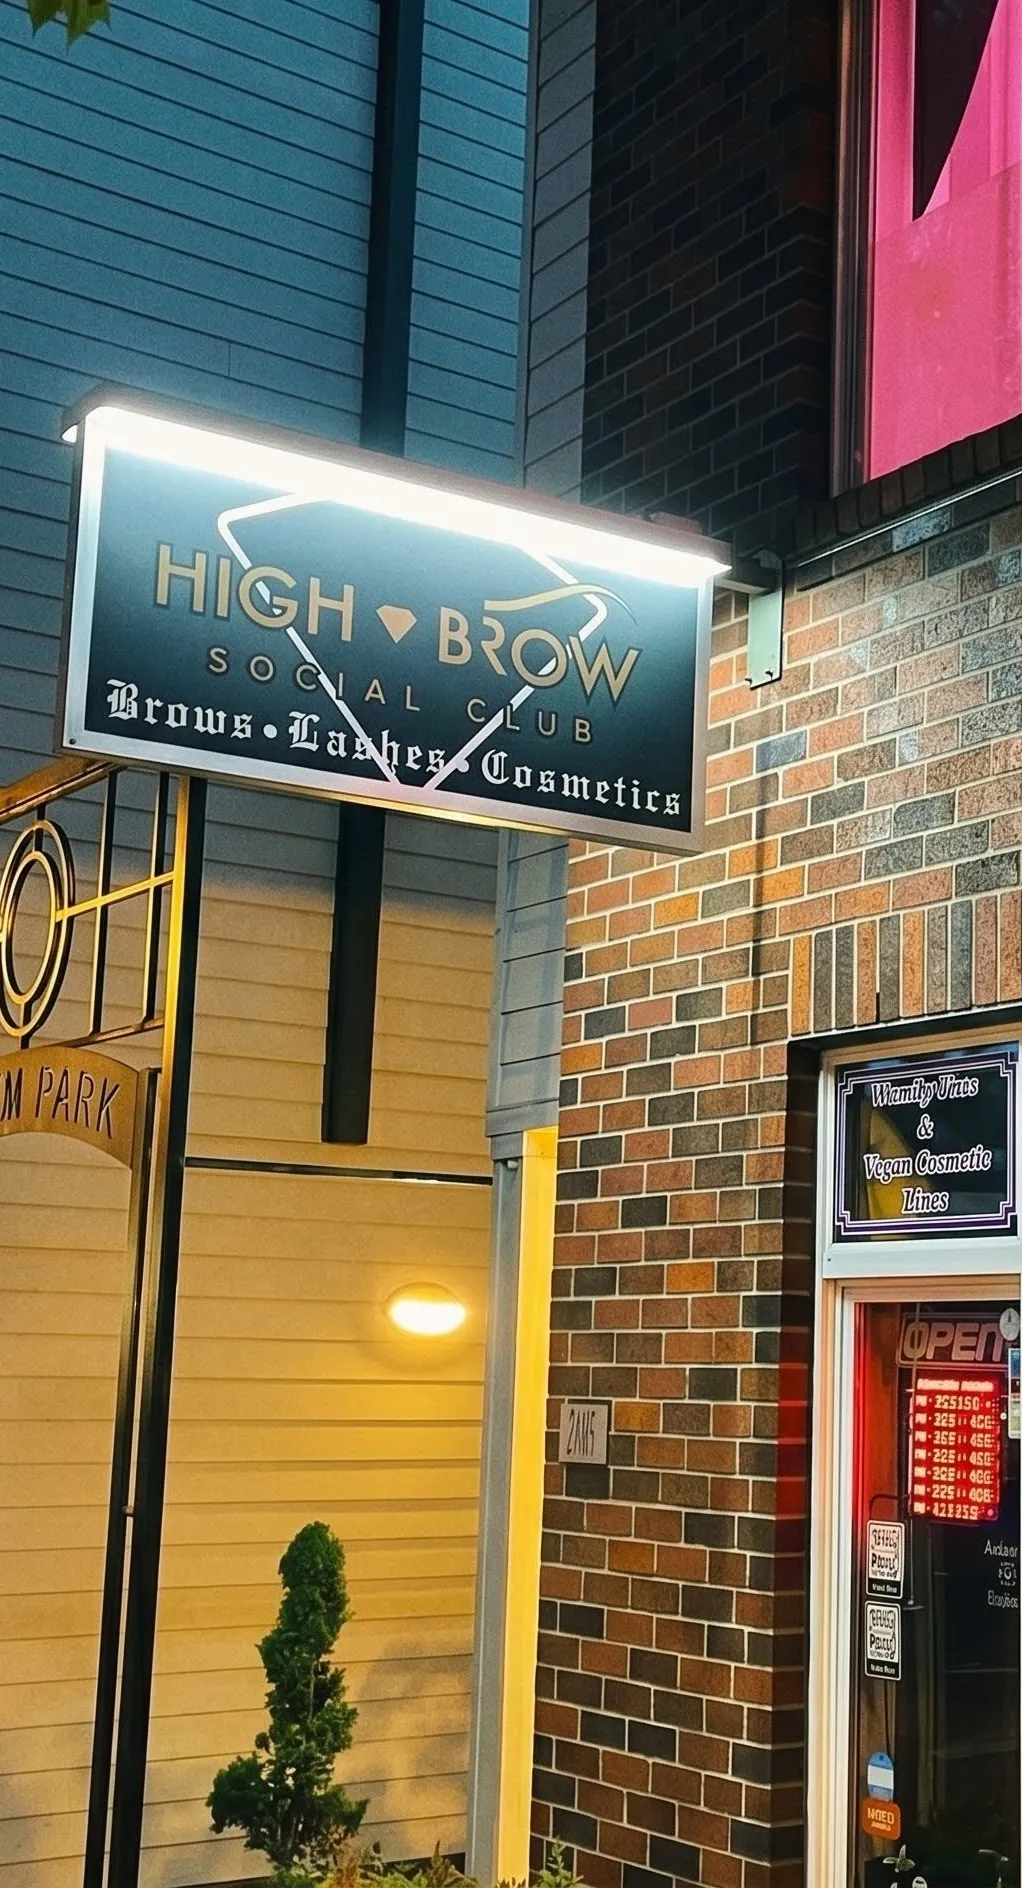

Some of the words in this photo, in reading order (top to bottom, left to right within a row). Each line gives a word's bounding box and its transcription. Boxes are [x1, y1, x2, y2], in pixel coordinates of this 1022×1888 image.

[155, 543, 355, 643] HIGH
[437, 596, 642, 703] BROW
[208, 647, 422, 712] SOCIAL
[466, 697, 593, 744] CLUB
[106, 678, 254, 740] Brows
[288, 710, 447, 776] Lashes
[481, 749, 682, 816] Cosmetics
[0, 1066, 23, 1122] M
[34, 1064, 121, 1140] PARK
[915, 1113, 935, 1140] &
[863, 1152, 913, 1185] Vegan
[914, 1143, 993, 1176] Cosmetic
[900, 1186, 950, 1214] Lines
[902, 1320, 1002, 1363] OPEN
